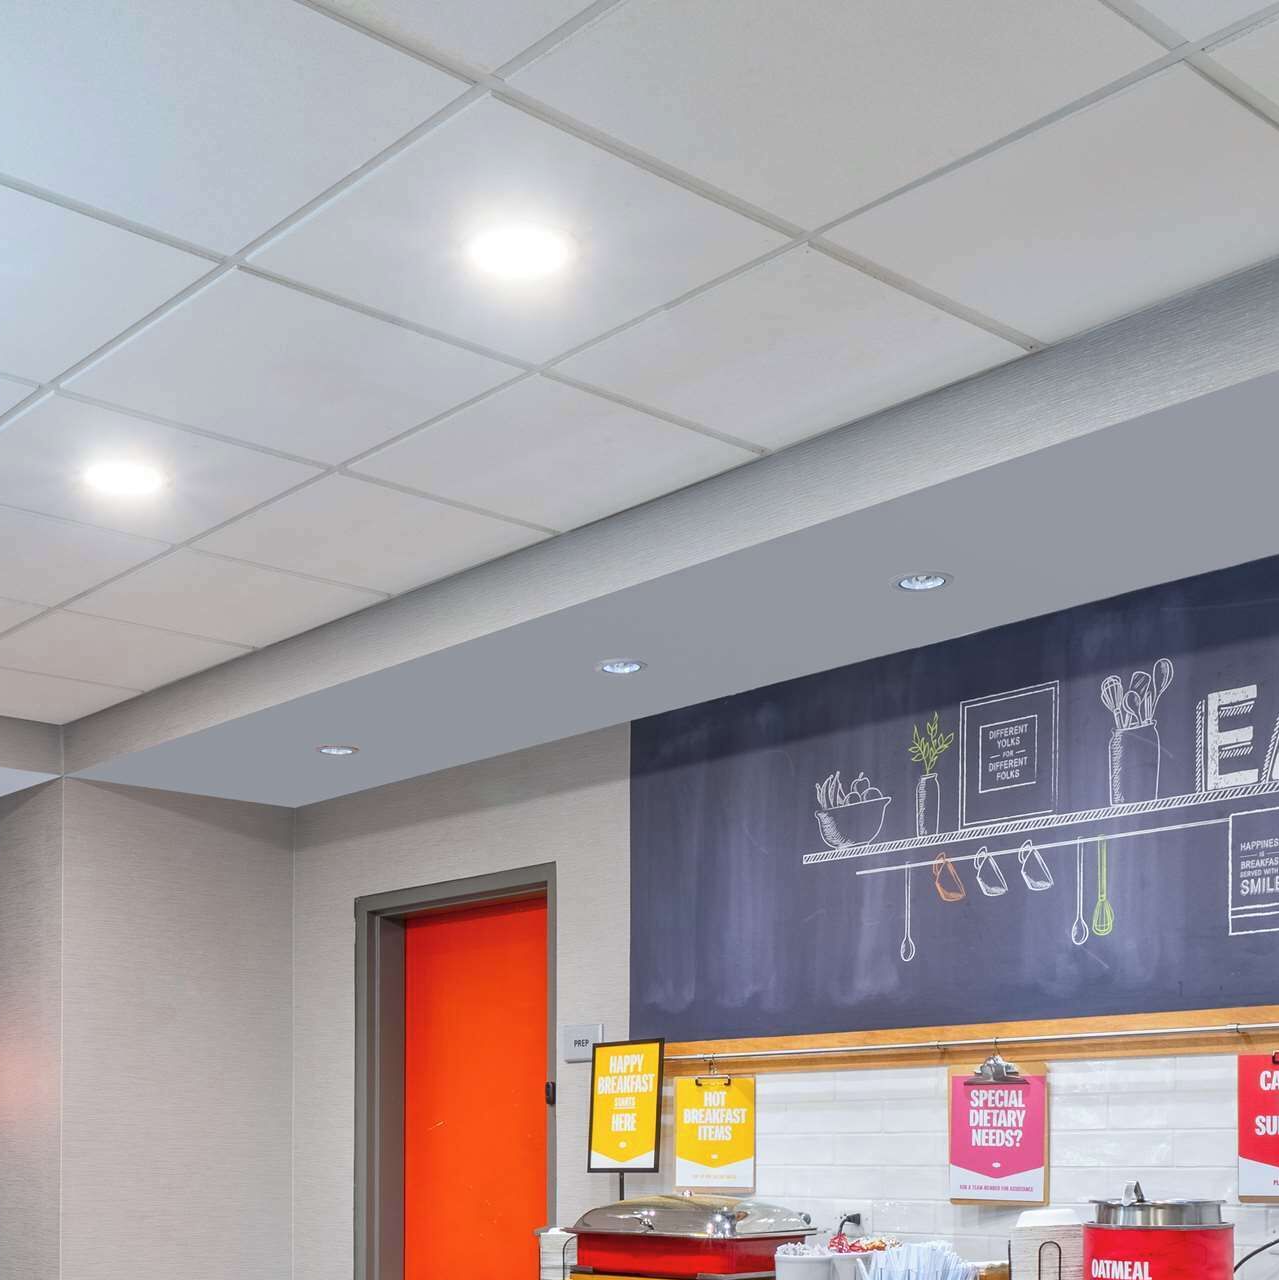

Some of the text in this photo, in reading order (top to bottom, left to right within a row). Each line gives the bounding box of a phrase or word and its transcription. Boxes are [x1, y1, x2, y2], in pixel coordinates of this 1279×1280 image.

[989, 723, 1028, 740] DIFFERENT
[997, 736, 1021, 749] YOLKS
[1002, 750, 1014, 758] FOR
[989, 756, 1028, 772] DIFFERENT
[996, 769, 1020, 781] FOLKS
[1240, 869, 1262, 878] SERVED
[1264, 867, 1279, 875] WITH
[573, 1039, 589, 1048] PREP
[609, 1054, 644, 1073] HAPPY
[598, 1074, 655, 1094] BREAKFAST
[704, 1091, 727, 1107] HOT
[970, 1089, 1026, 1108] SPECIAL
[611, 1113, 637, 1132] HERE
[683, 1108, 747, 1124] BREAKFAST
[969, 1109, 1026, 1127] DIETARY
[698, 1125, 732, 1141] ITEMS
[971, 1129, 1023, 1147] NEEDS?
[1091, 1258, 1152, 1280] OATMEAL
